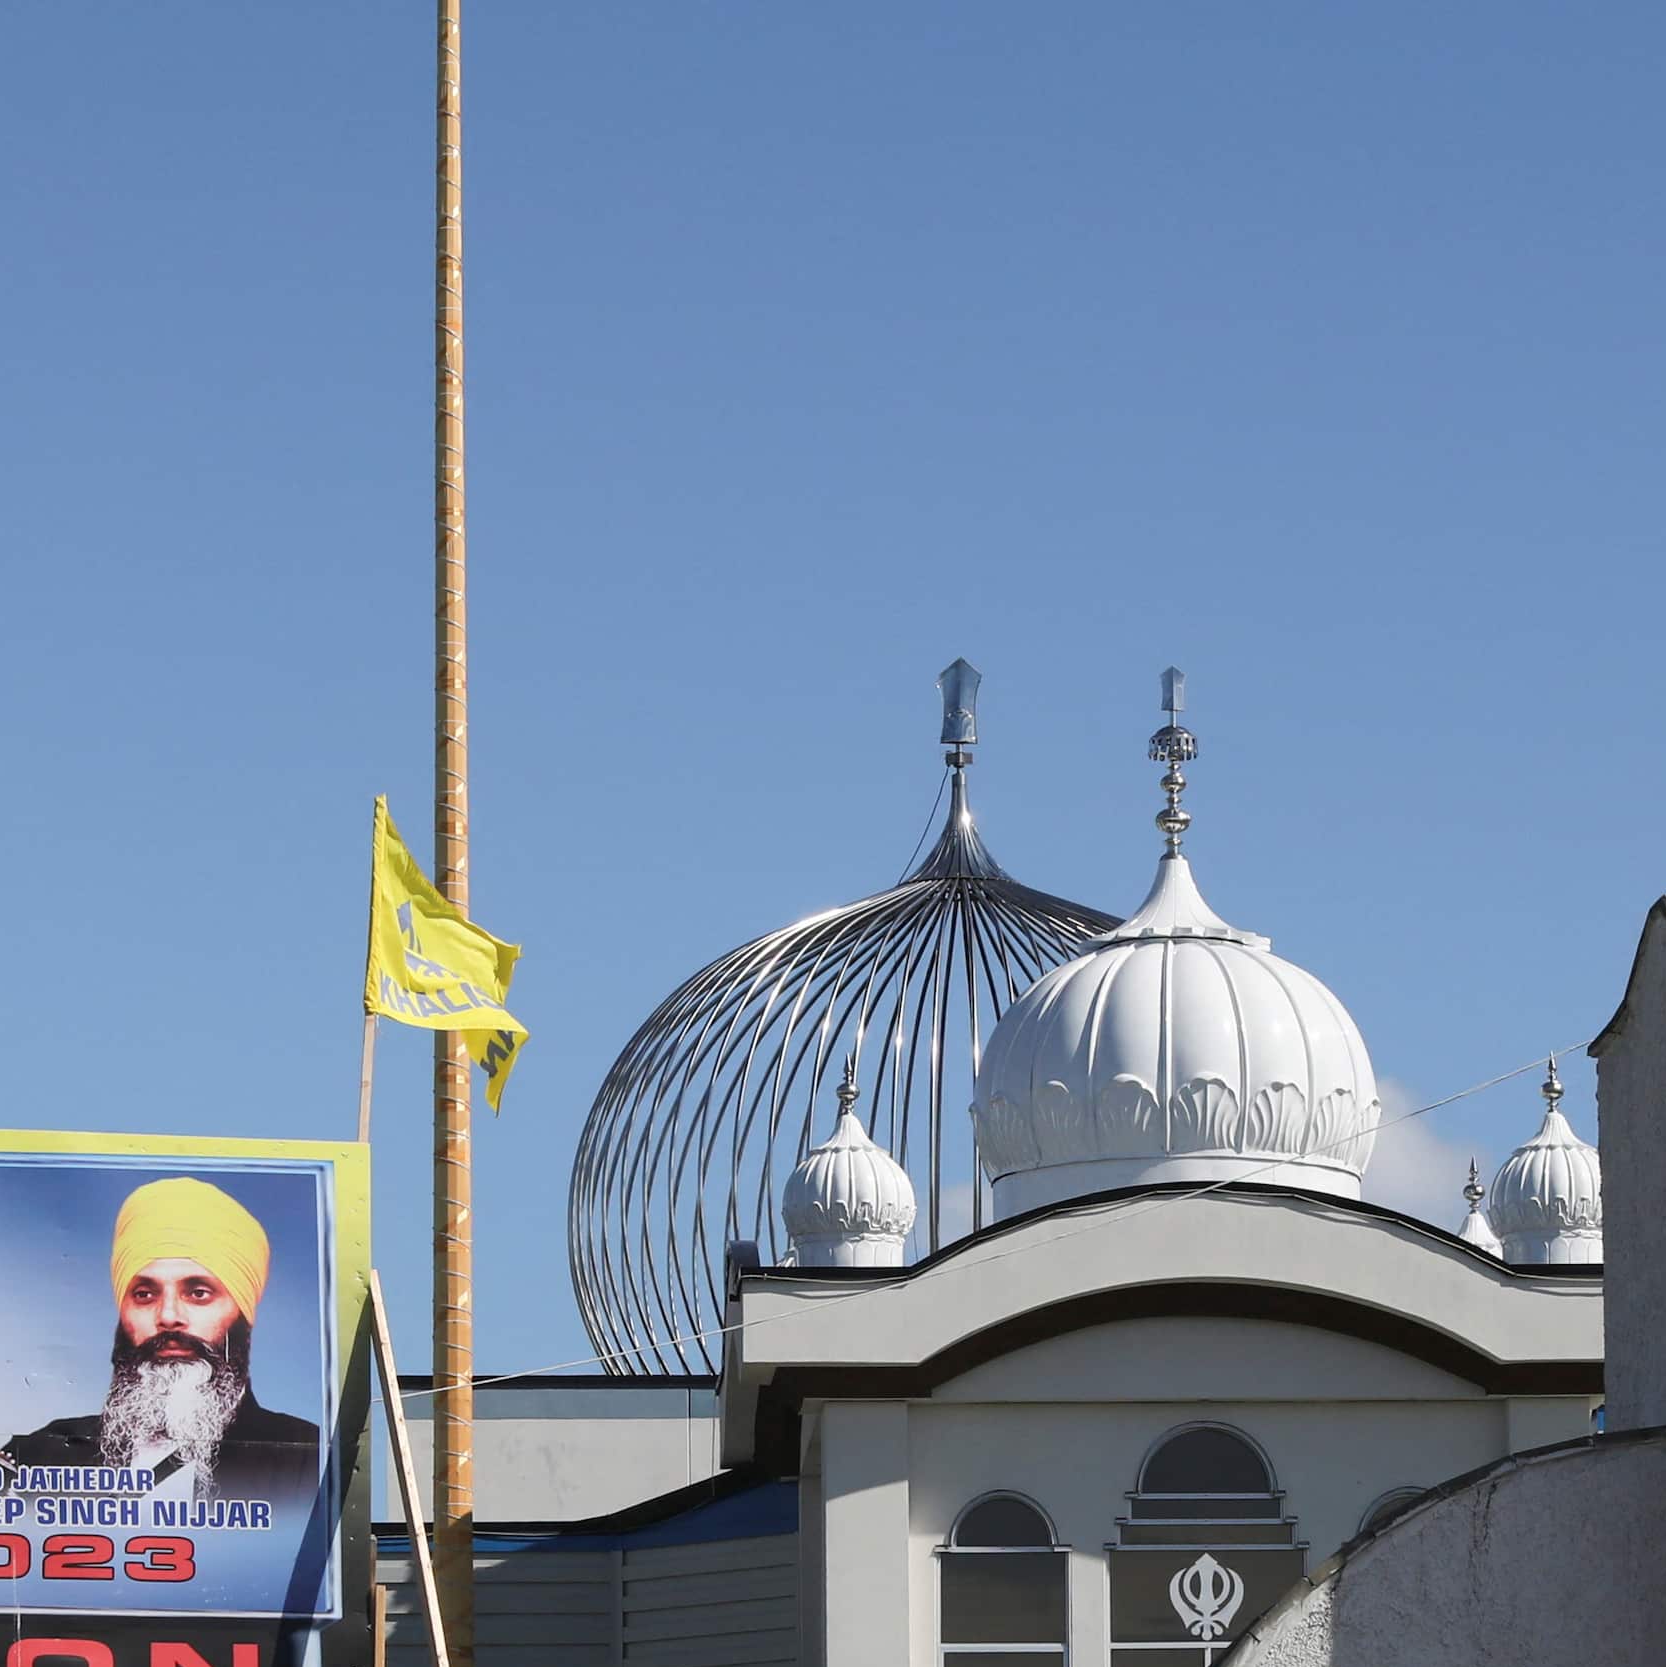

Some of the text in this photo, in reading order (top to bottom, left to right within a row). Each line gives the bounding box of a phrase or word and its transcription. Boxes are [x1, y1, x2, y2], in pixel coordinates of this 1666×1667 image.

[15, 1466, 154, 1492] JATHEDAR
[36, 1498, 142, 1528] SINGH
[153, 1499, 272, 1530] NIJJAR
